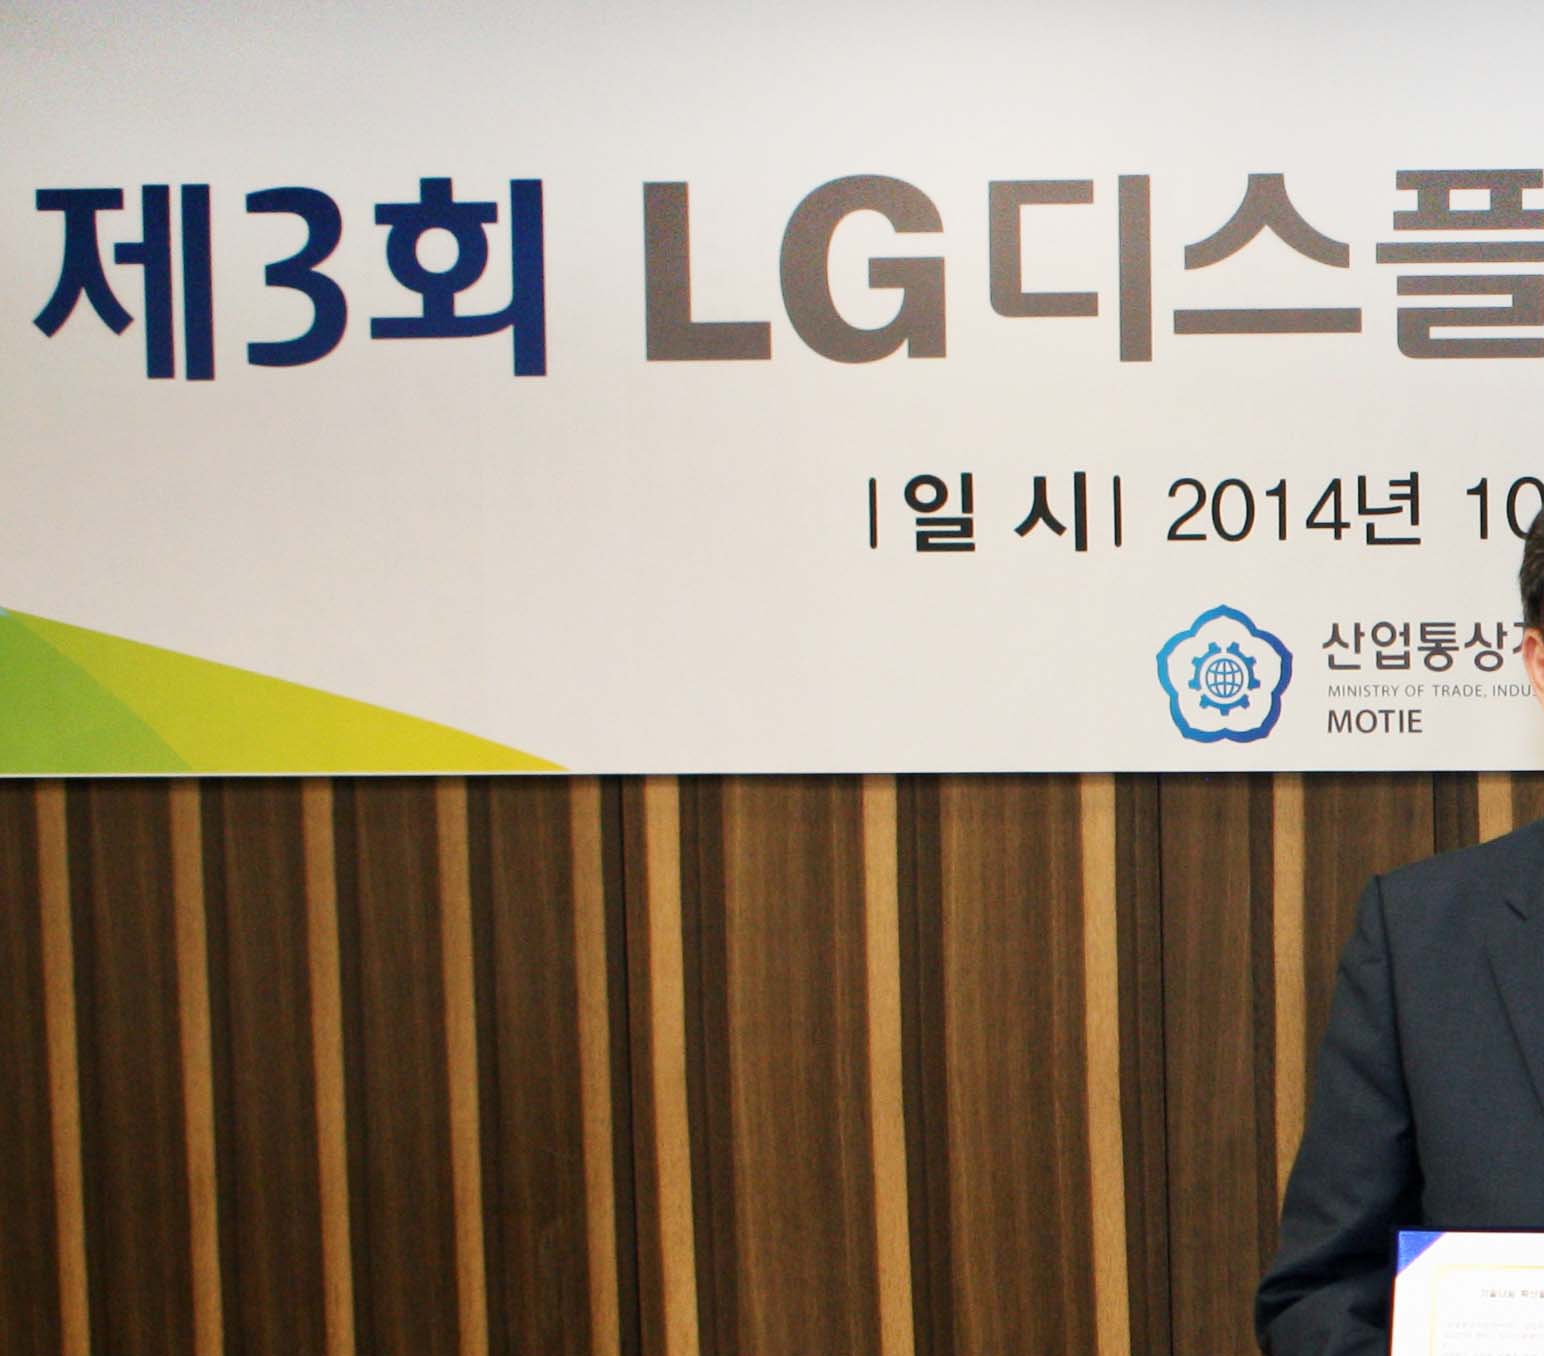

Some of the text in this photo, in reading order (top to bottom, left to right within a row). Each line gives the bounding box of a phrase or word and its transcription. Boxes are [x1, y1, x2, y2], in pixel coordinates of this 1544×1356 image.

[32, 176, 547, 381] 제3회
[1166, 471, 1422, 546] 2014년
[1328, 684, 1398, 698] MINISTRY
[1405, 684, 1425, 698] OF
[1327, 709, 1423, 734] MOTIE
